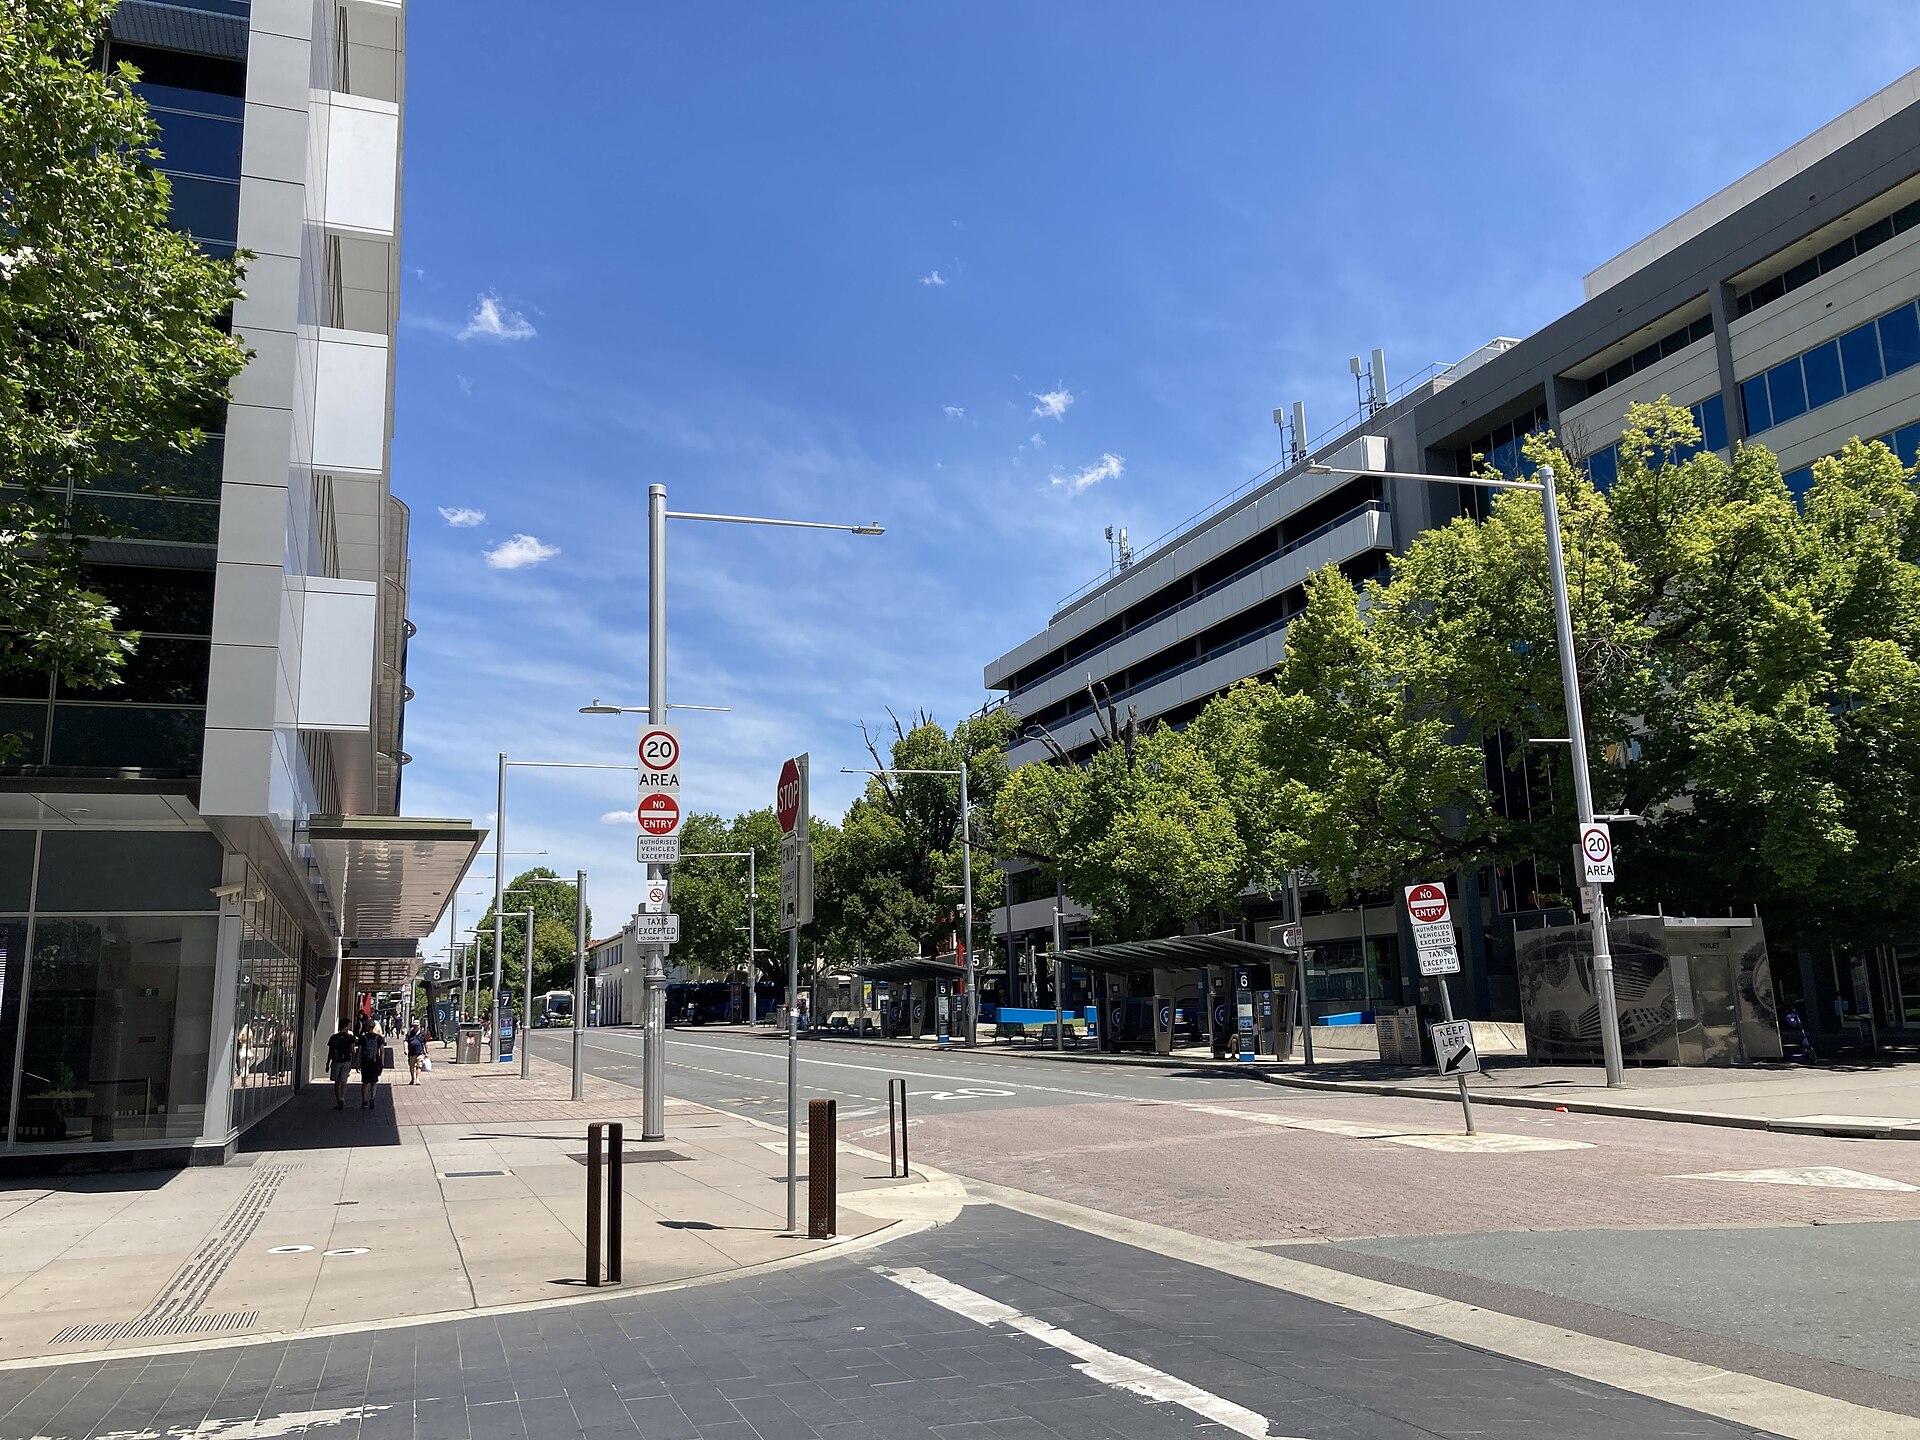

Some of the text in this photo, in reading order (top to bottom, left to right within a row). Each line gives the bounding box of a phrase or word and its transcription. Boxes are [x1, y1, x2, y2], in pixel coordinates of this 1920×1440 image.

[647, 742, 671, 758] 20
[639, 773, 680, 787] AREA
[779, 780, 798, 813] STOP
[652, 801, 666, 809] NO
[643, 819, 674, 829] ENTRY
[1588, 837, 1606, 852] 20
[782, 845, 794, 864] END
[1586, 865, 1614, 876] AREA
[1419, 890, 1432, 899] NO
[1415, 907, 1442, 917] ENTRY
[647, 918, 669, 926] TAXIS
[638, 927, 676, 935] EXCEPTED
[1416, 923, 1450, 933] AUTHORISED
[1418, 931, 1450, 939] VEHICLES
[1420, 937, 1451, 946] EXCEPTED
[972, 954, 980, 966] 5
[1423, 958, 1456, 968] EXCEPTED
[433, 970, 441, 980] 8
[1240, 974, 1248, 987] 6
[940, 985, 946, 994] 5
[502, 996, 510, 1006] 7
[1442, 1036, 1465, 1047] LEFT
